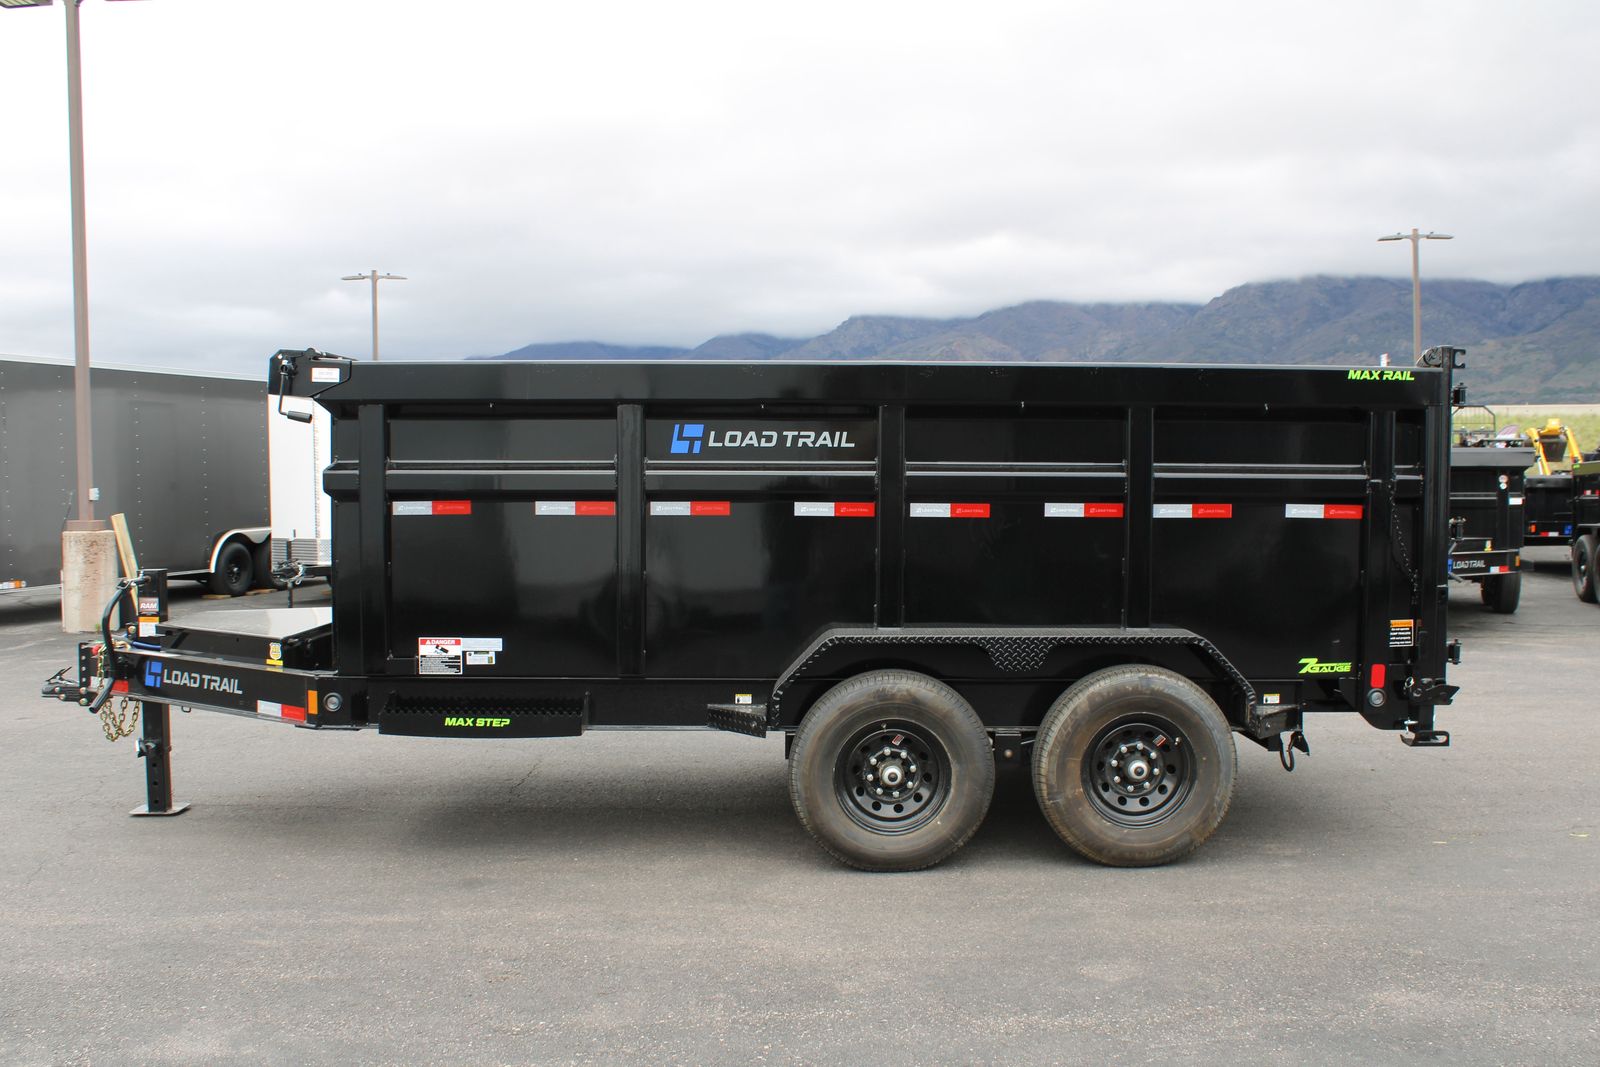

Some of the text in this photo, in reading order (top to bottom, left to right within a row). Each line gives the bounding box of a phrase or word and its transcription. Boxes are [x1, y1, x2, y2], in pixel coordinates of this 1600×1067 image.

[1347, 369, 1415, 381] MAX RAIL
[708, 430, 855, 448] LOAD TRAIL
[1453, 560, 1486, 569] LOAD TRAIL
[163, 668, 243, 695] LOAD TRAIL
[444, 717, 511, 728] MAX STEP
